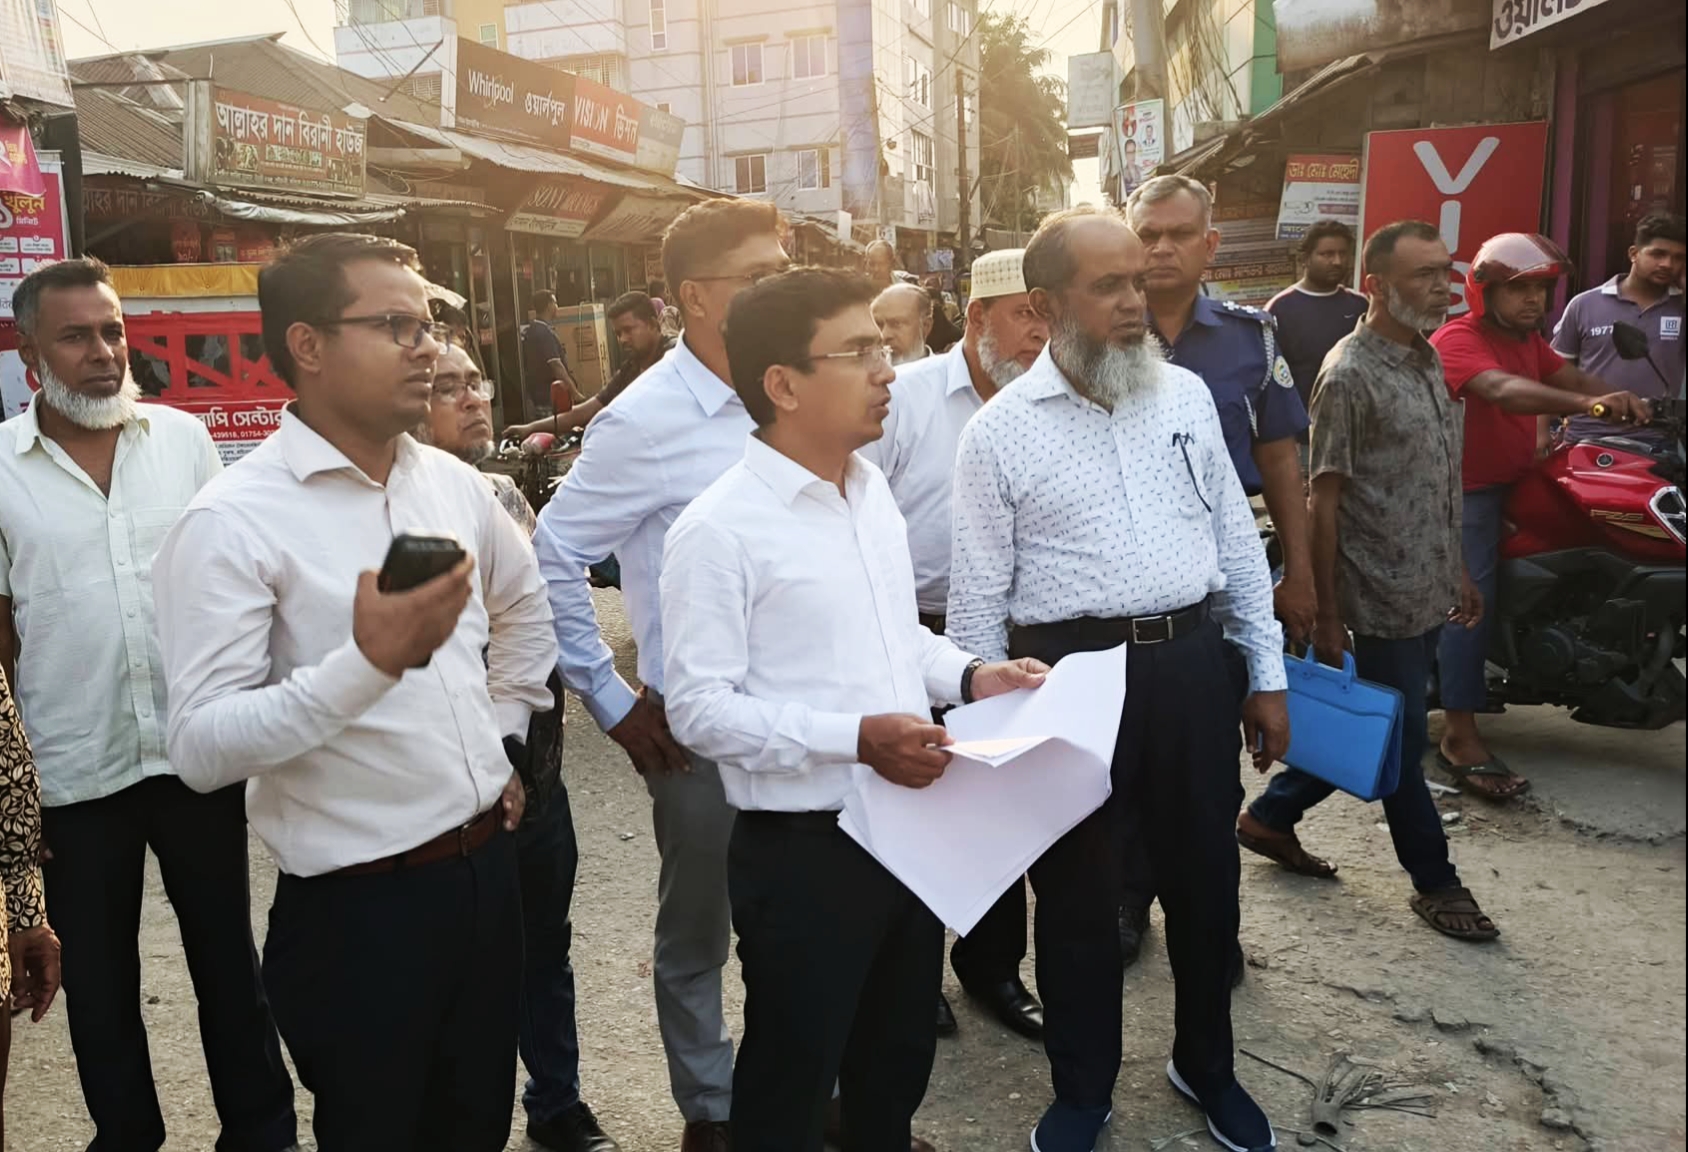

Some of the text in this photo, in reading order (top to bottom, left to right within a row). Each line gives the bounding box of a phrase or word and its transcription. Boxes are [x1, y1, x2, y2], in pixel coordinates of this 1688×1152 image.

[468, 68, 514, 107] Whirlpool
[215, 101, 269, 143] আল্লাহর
[271, 112, 295, 146] দান
[1308, 162, 1327, 178] মোঃ
[5, 196, 46, 214] খুলুন
[1590, 325, 1614, 336] 1977
